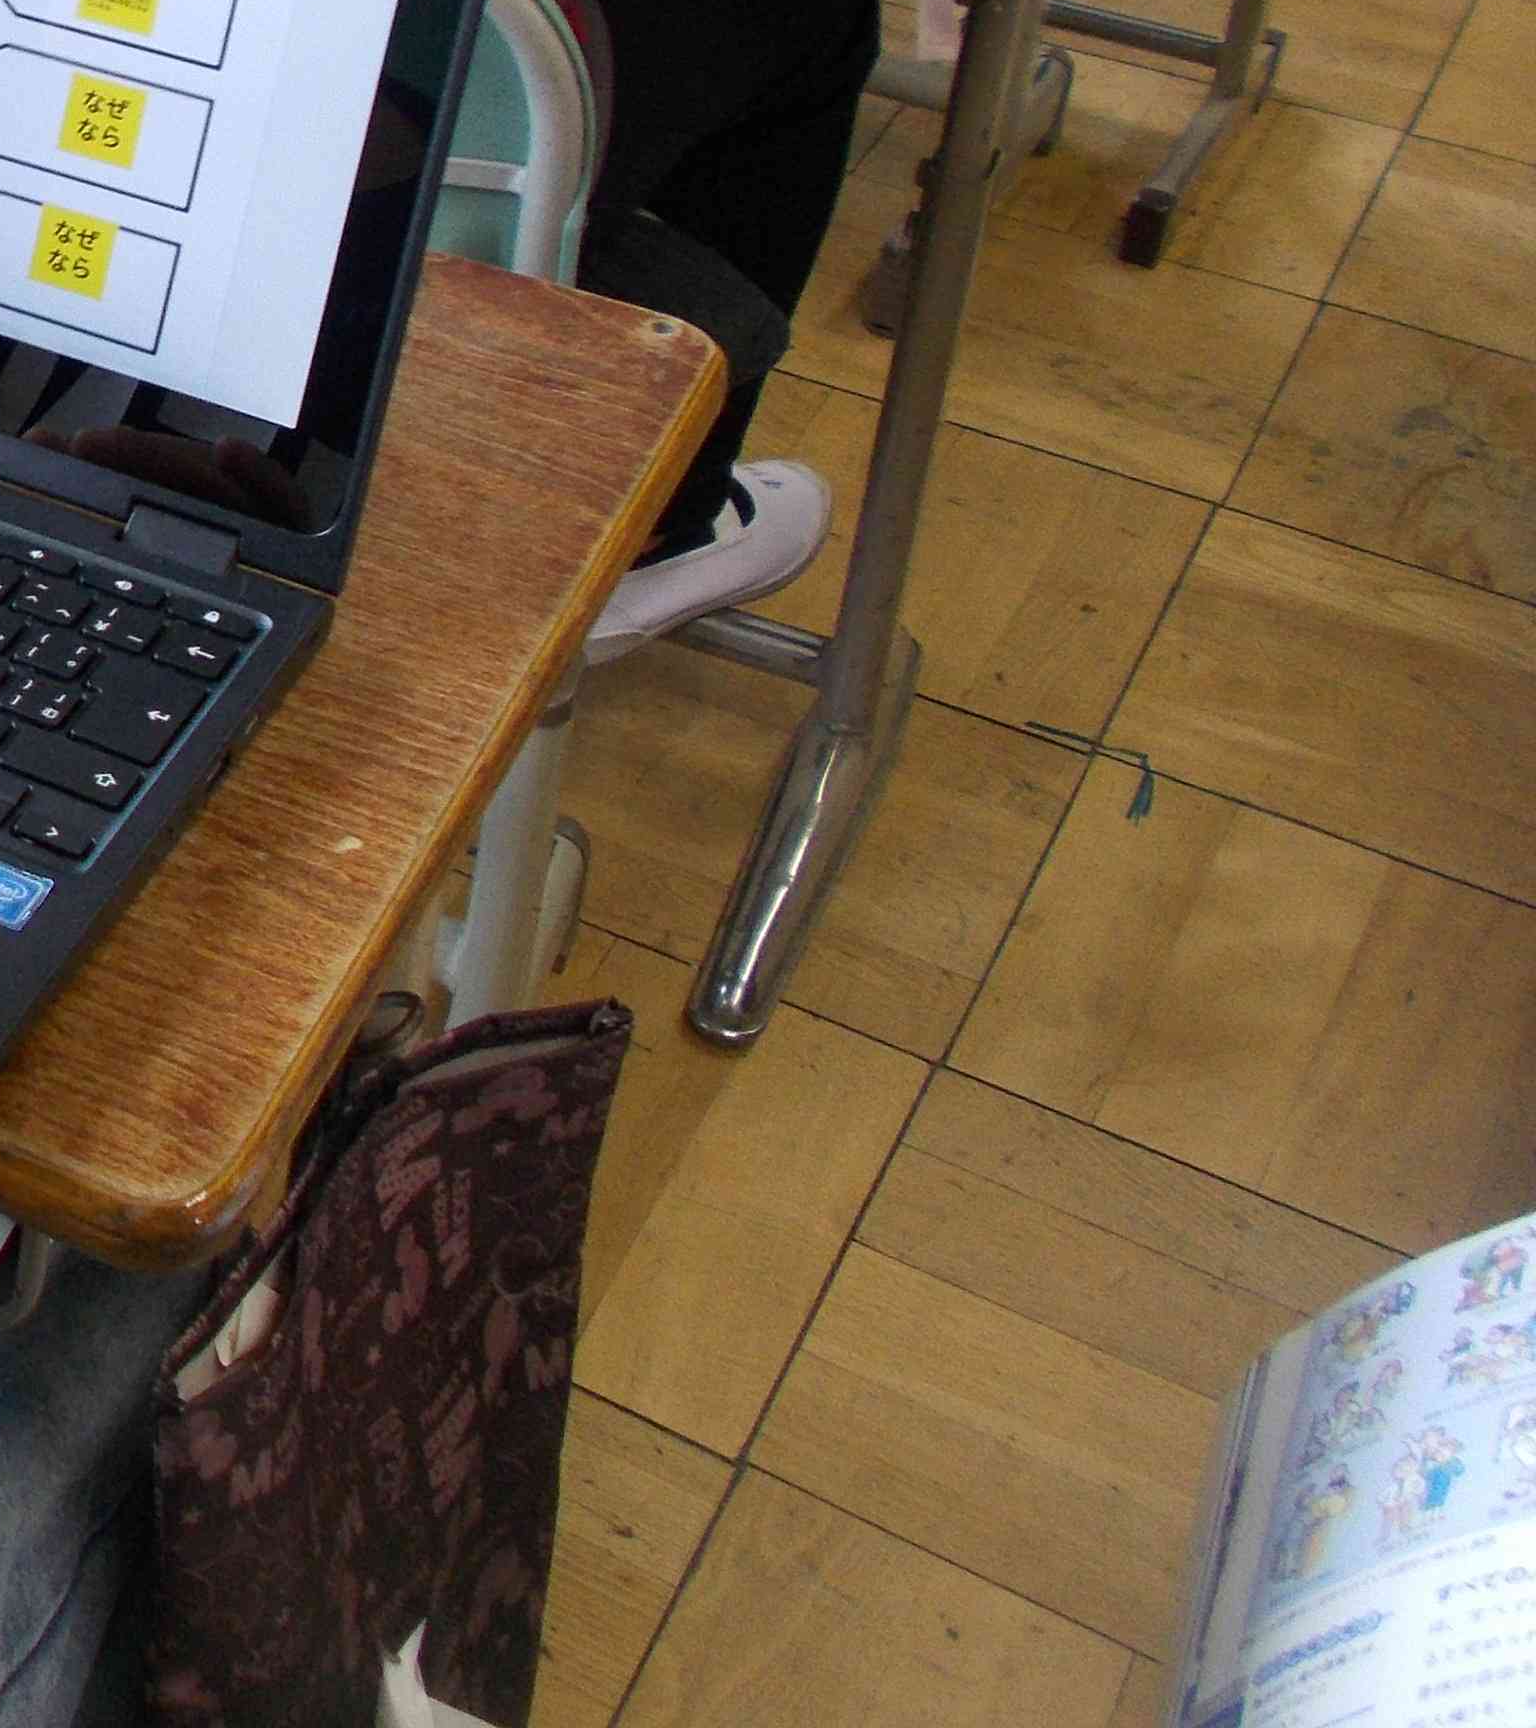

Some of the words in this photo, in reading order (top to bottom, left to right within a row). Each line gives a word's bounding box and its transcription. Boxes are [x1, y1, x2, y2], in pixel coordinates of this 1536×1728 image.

[83, 89, 132, 121] なぜ
[76, 118, 121, 149] なら
[54, 220, 101, 252] なぜ
[47, 248, 91, 280] なら
